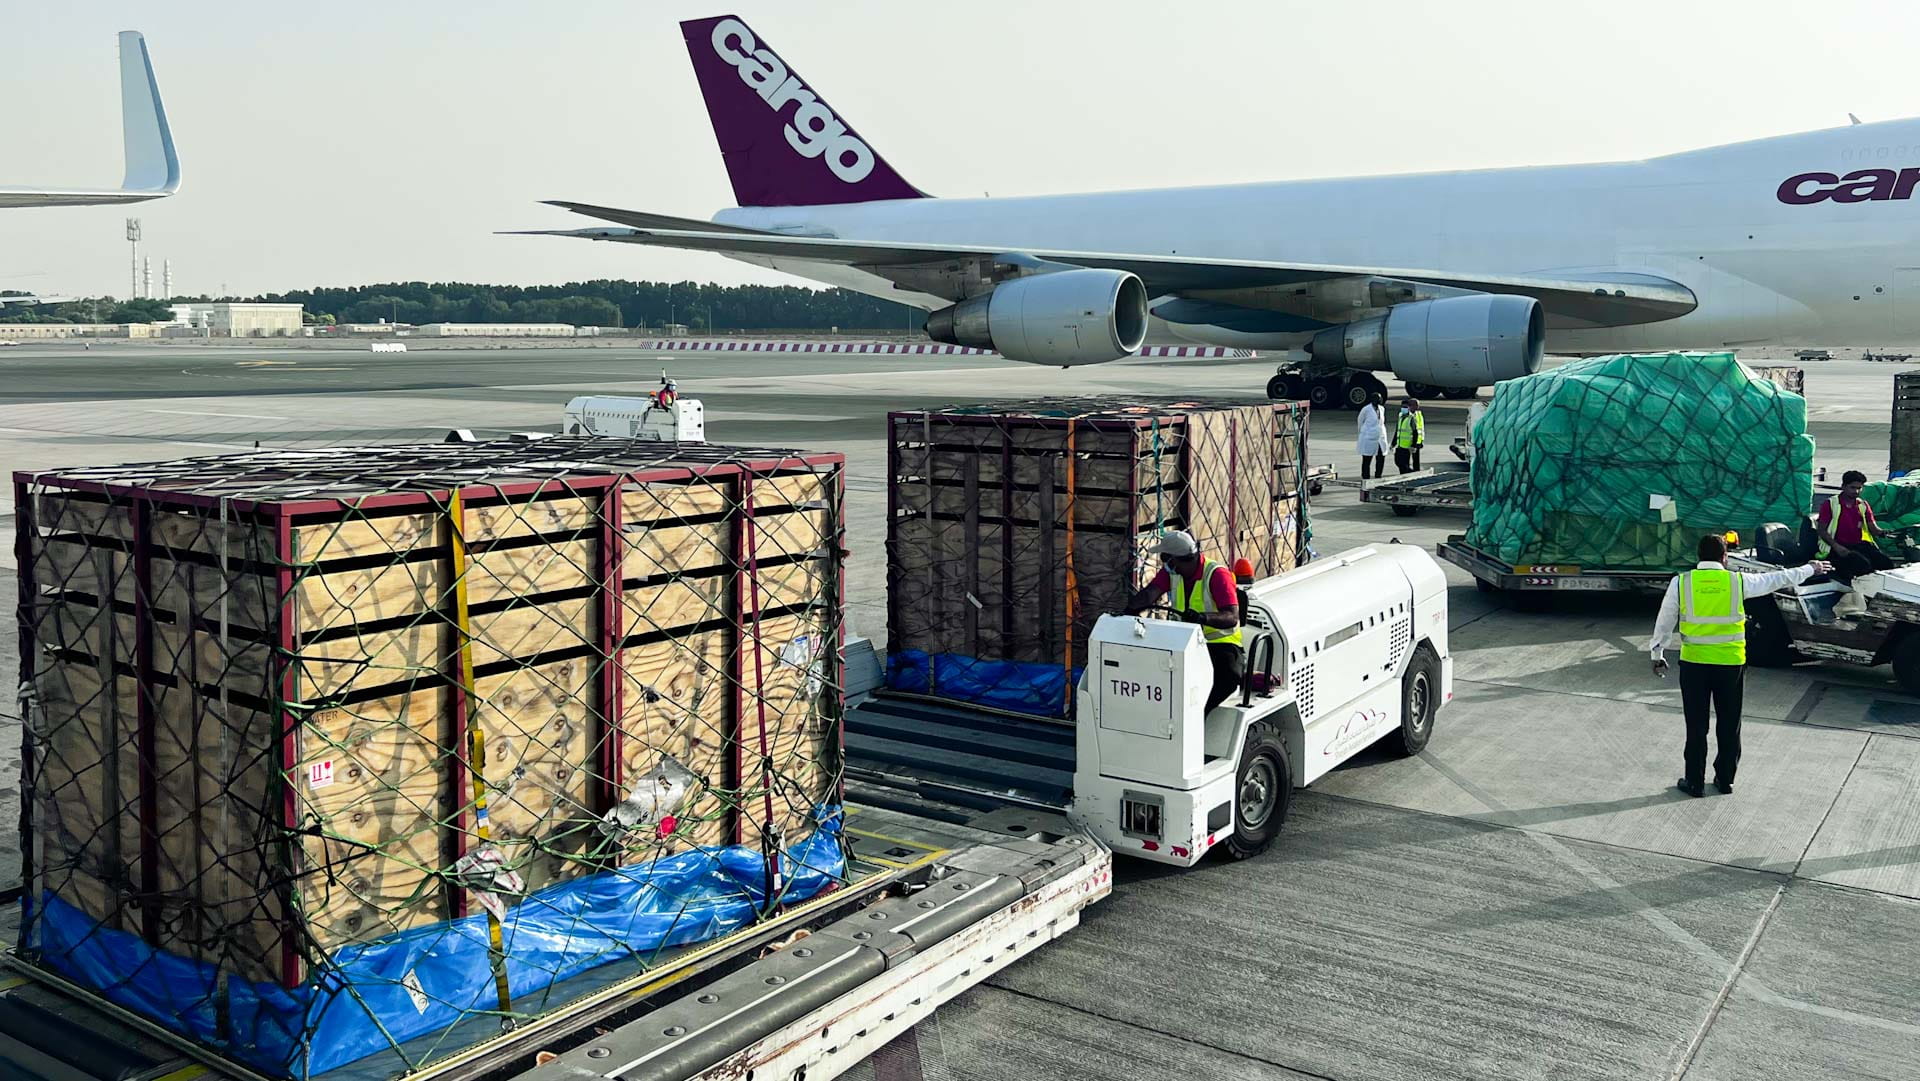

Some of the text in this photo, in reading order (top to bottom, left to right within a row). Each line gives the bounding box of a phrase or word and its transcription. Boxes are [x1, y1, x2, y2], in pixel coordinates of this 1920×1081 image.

[711, 18, 875, 183] cargo
[1110, 679, 1162, 702] TRP 18
